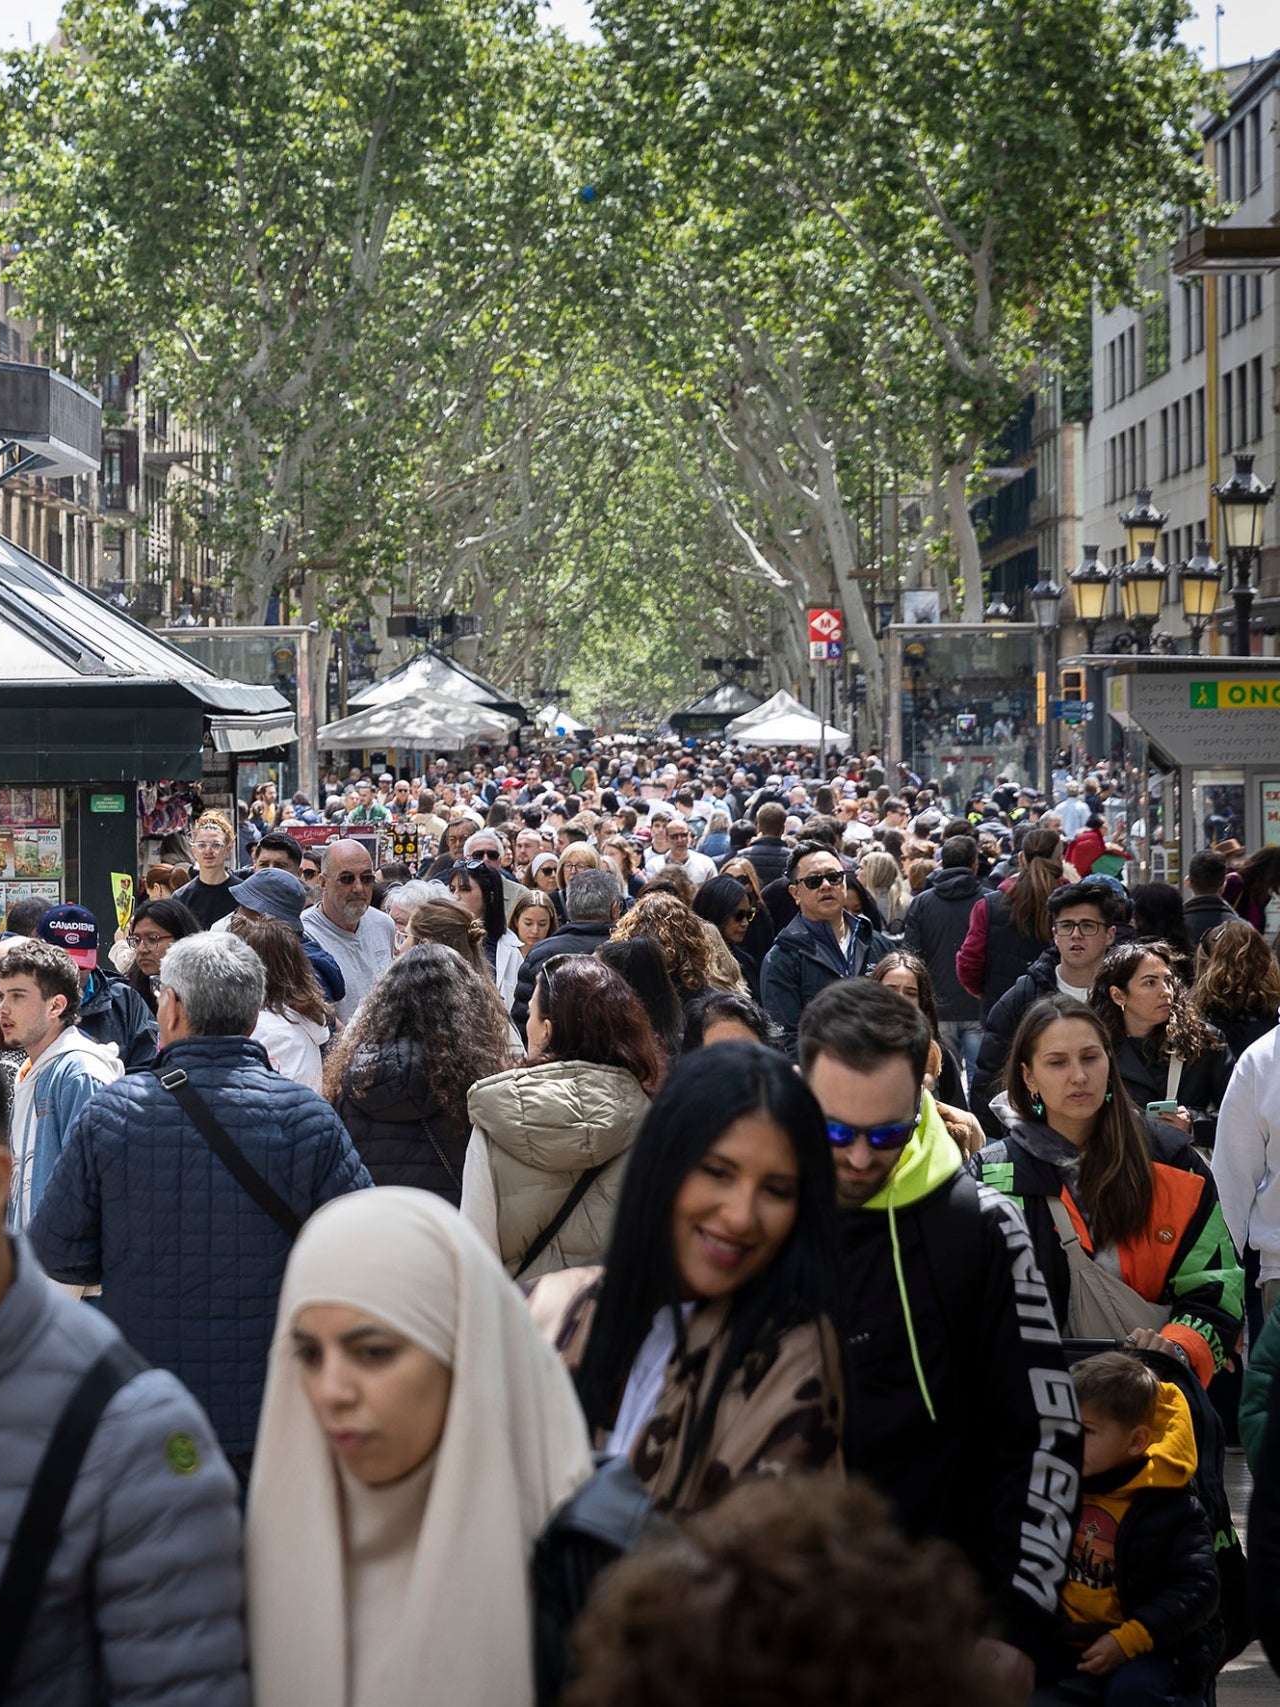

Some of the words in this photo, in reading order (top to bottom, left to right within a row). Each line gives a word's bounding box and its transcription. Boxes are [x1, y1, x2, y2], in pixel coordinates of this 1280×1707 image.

[820, 619, 831, 628] M
[49, 920, 95, 932] CANADIENS
[1011, 1366, 1084, 1615] GLEAM
